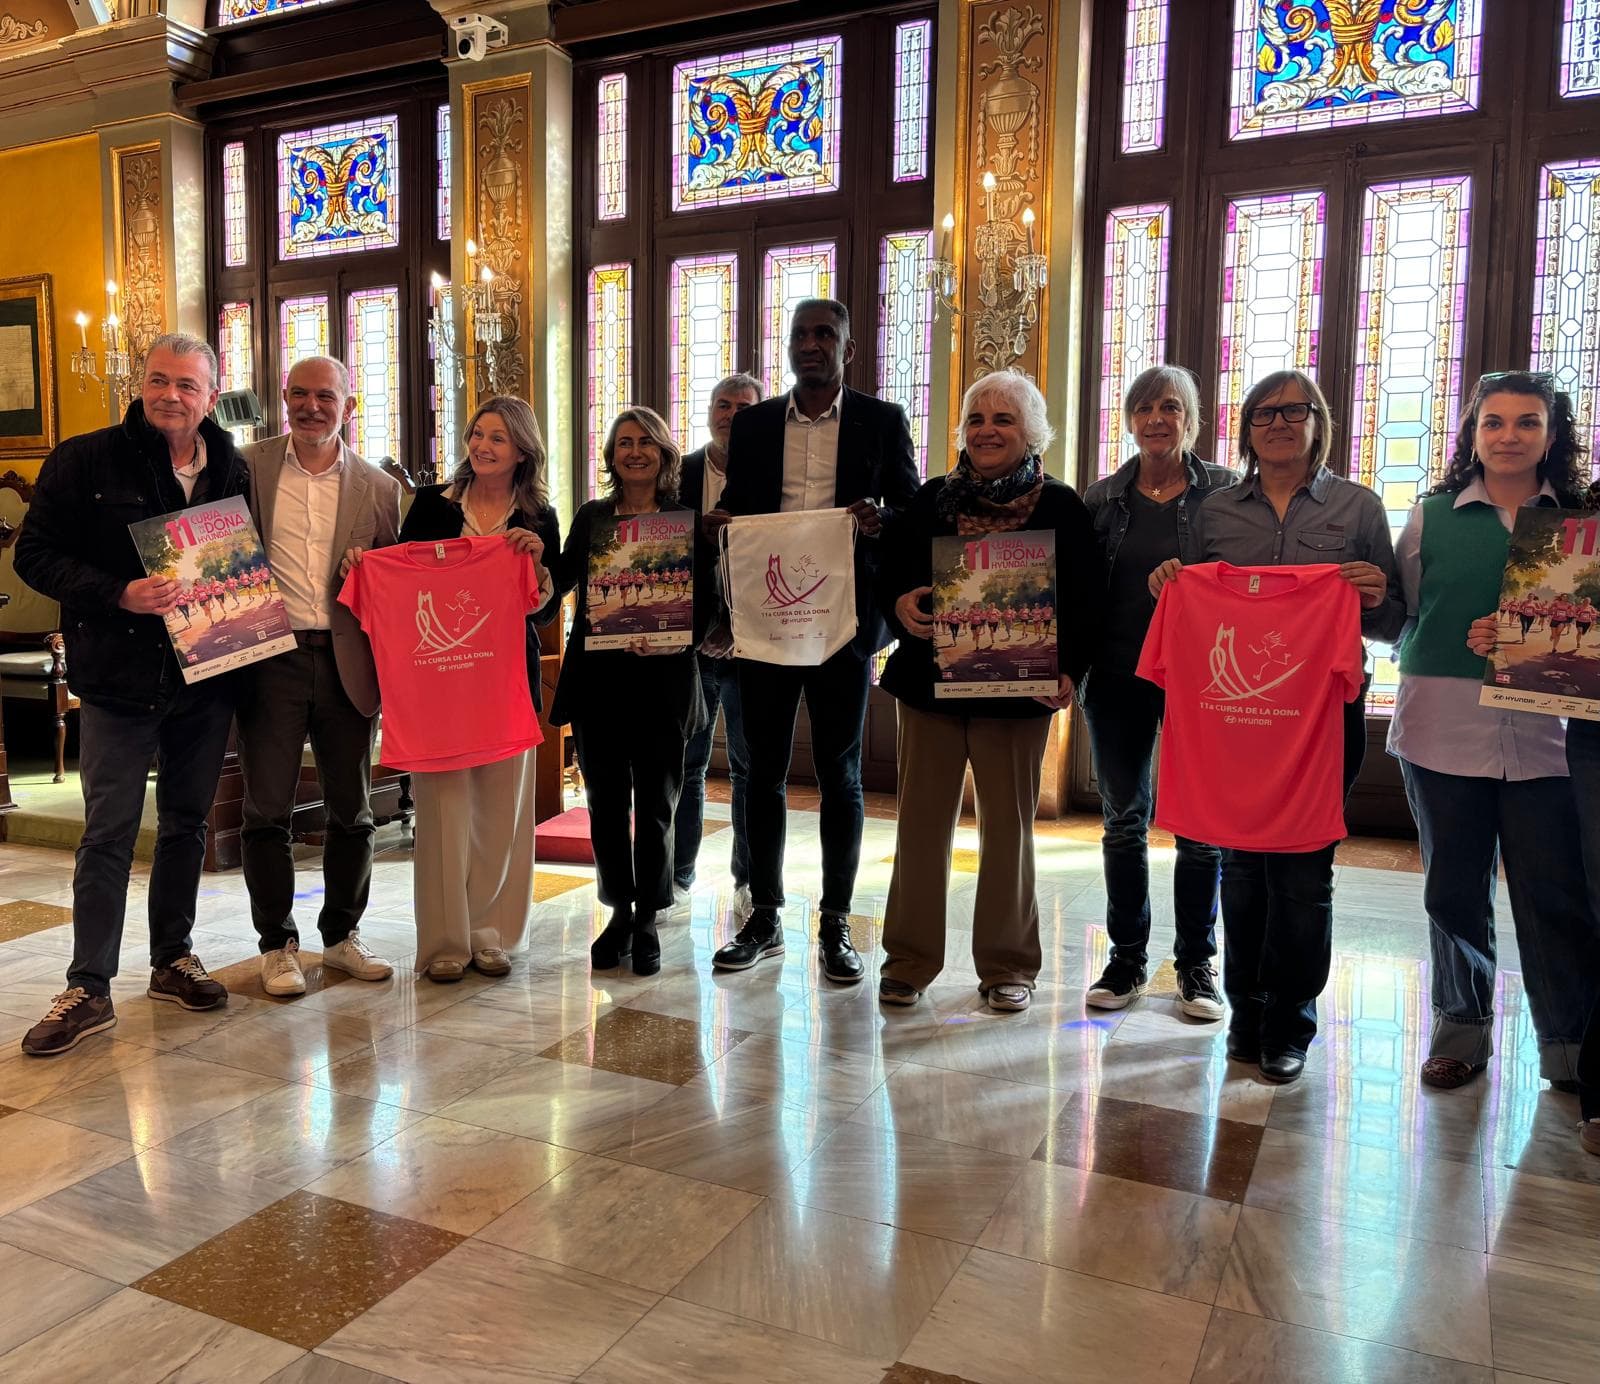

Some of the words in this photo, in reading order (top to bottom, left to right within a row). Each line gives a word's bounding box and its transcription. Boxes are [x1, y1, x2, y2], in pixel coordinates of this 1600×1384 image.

[204, 513, 245, 533] DONA
[650, 524, 687, 535] DONA
[165, 518, 197, 550] 11
[618, 519, 639, 544] 11
[1561, 518, 1597, 555] 11
[965, 541, 989, 570] 11
[1003, 548, 1046, 561] DONA
[991, 560, 1028, 569] HYUNDAI
[427, 656, 451, 665] CURSA
[1200, 702, 1214, 710] 11a
[1215, 704, 1243, 713] CURSA
[1259, 707, 1271, 715] LA
